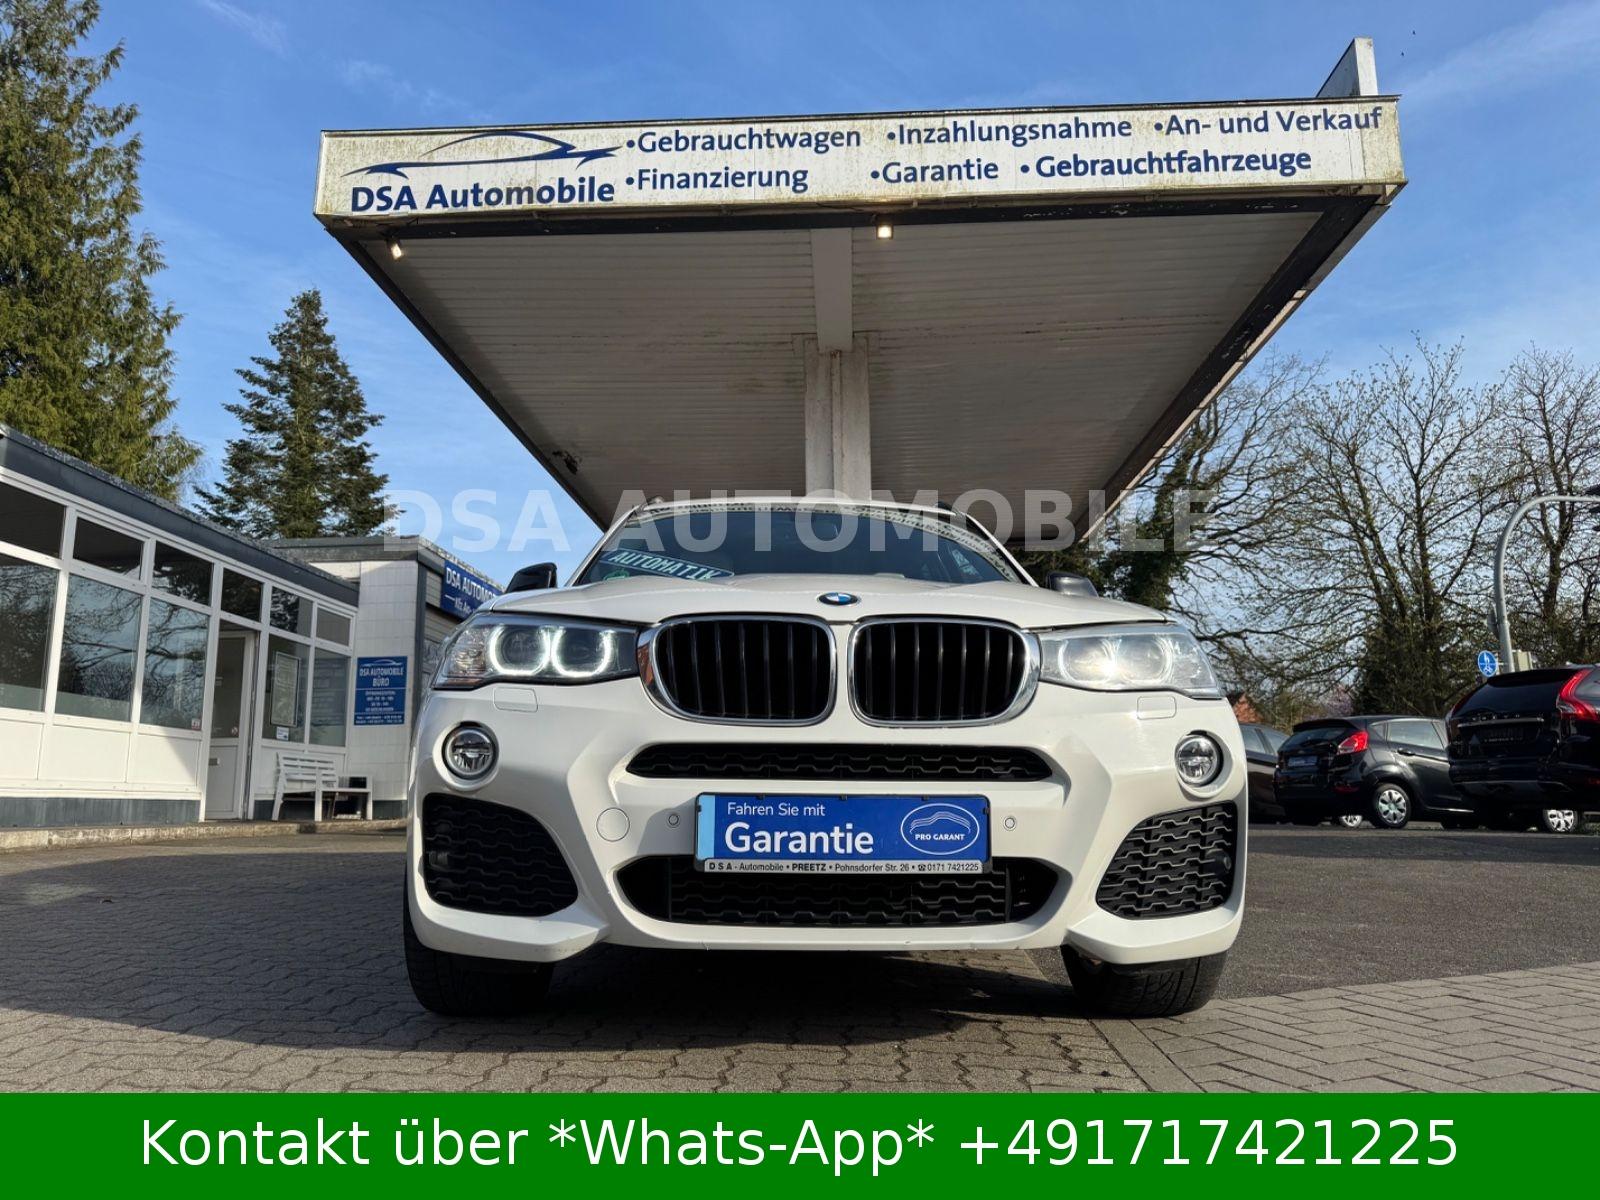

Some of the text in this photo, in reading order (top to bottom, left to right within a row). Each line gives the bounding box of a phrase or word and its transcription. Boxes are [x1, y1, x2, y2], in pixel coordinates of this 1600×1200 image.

[899, 117, 1132, 147] Inzahlungsnahme
[1166, 107, 1382, 135] An- und Verkauf
[638, 126, 861, 155] Gebrauchtwagen
[638, 165, 809, 193] Finanzierung
[882, 158, 999, 183] Garantie
[1035, 149, 1311, 181] Gebrauchtfahrzeuge
[351, 176, 615, 212] DSA Automobile
[446, 567, 461, 589] DSA
[608, 551, 722, 580] AUTOMATIK
[728, 803, 826, 817] Fahren Sie mit
[724, 822, 874, 854] Garantie
[914, 833, 965, 841] PRO GARANT
[740, 862, 784, 871] Automobile
[792, 863, 827, 871] PREETZ
[835, 863, 883, 872] Pohnsdorfer
[885, 864, 899, 872] Str.
[900, 864, 910, 872] 26
[948, 863, 979, 871] 7421225
